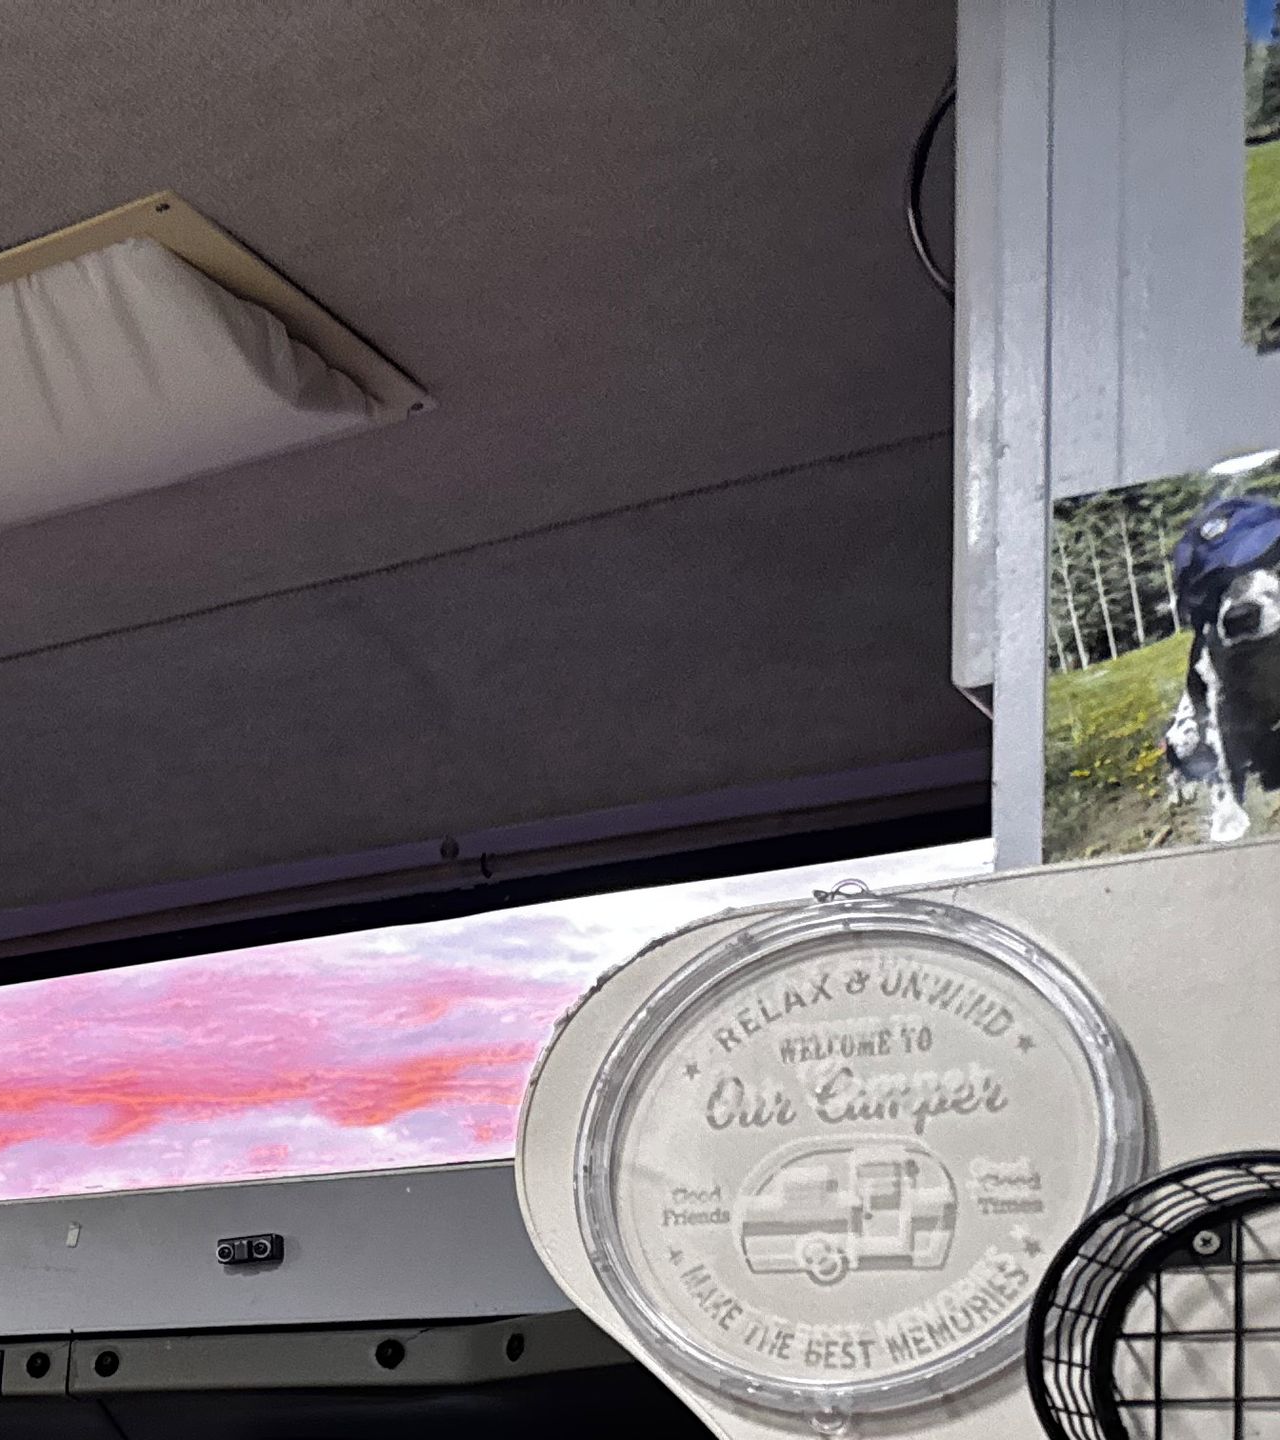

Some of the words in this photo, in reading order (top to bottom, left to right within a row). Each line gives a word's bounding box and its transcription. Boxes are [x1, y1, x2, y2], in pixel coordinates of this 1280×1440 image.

[714, 971, 834, 1053] RELAX
[900, 1024, 933, 1054] TO
[705, 1075, 797, 1131] Our
[661, 1206, 731, 1228] Friends
